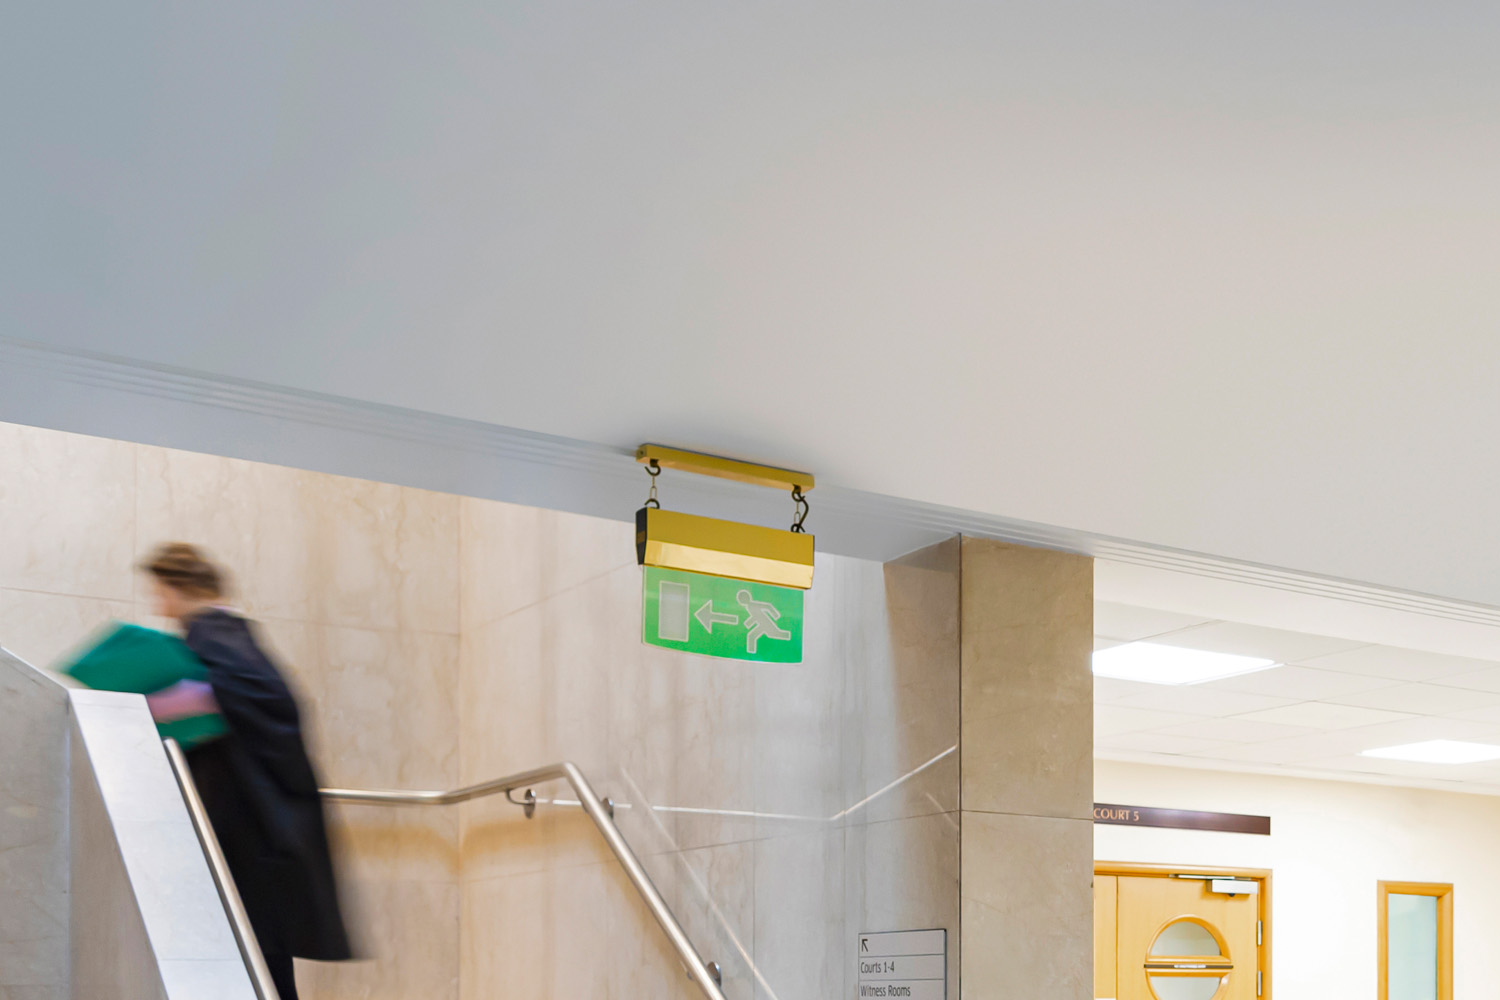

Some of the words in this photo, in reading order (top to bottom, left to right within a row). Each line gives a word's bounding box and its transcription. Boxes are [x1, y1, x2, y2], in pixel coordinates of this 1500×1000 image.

[1093, 808, 1130, 822] COURT
[1133, 810, 1140, 822] 5
[860, 961, 882, 974] Courts
[883, 961, 895, 973] 1-4
[860, 985, 887, 998] Witness
[887, 985, 911, 998] Rooms
